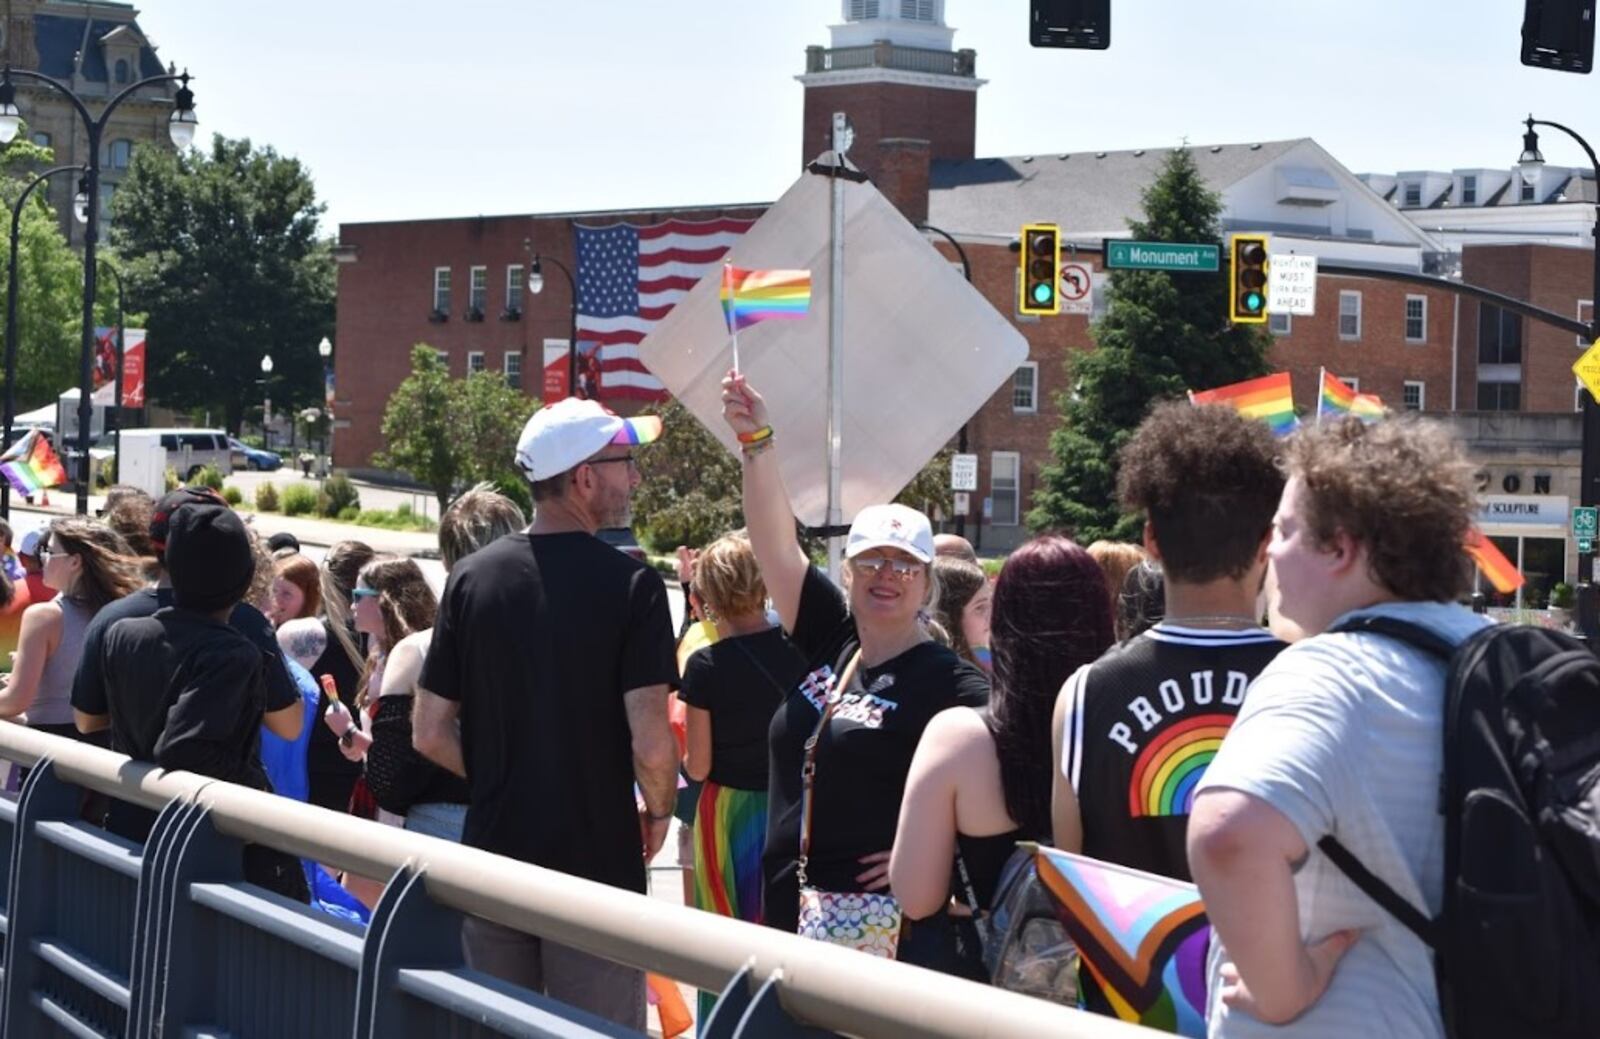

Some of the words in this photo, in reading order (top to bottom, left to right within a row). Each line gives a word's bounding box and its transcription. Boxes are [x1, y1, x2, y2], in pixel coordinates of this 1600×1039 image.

[1130, 247, 1200, 266] Monument
[1202, 250, 1217, 259] Ave
[1280, 271, 1305, 282] MUST
[1277, 297, 1306, 308] AHEAD
[1493, 503, 1540, 514] SCULPTURE
[1108, 670, 1248, 754] PROUD
